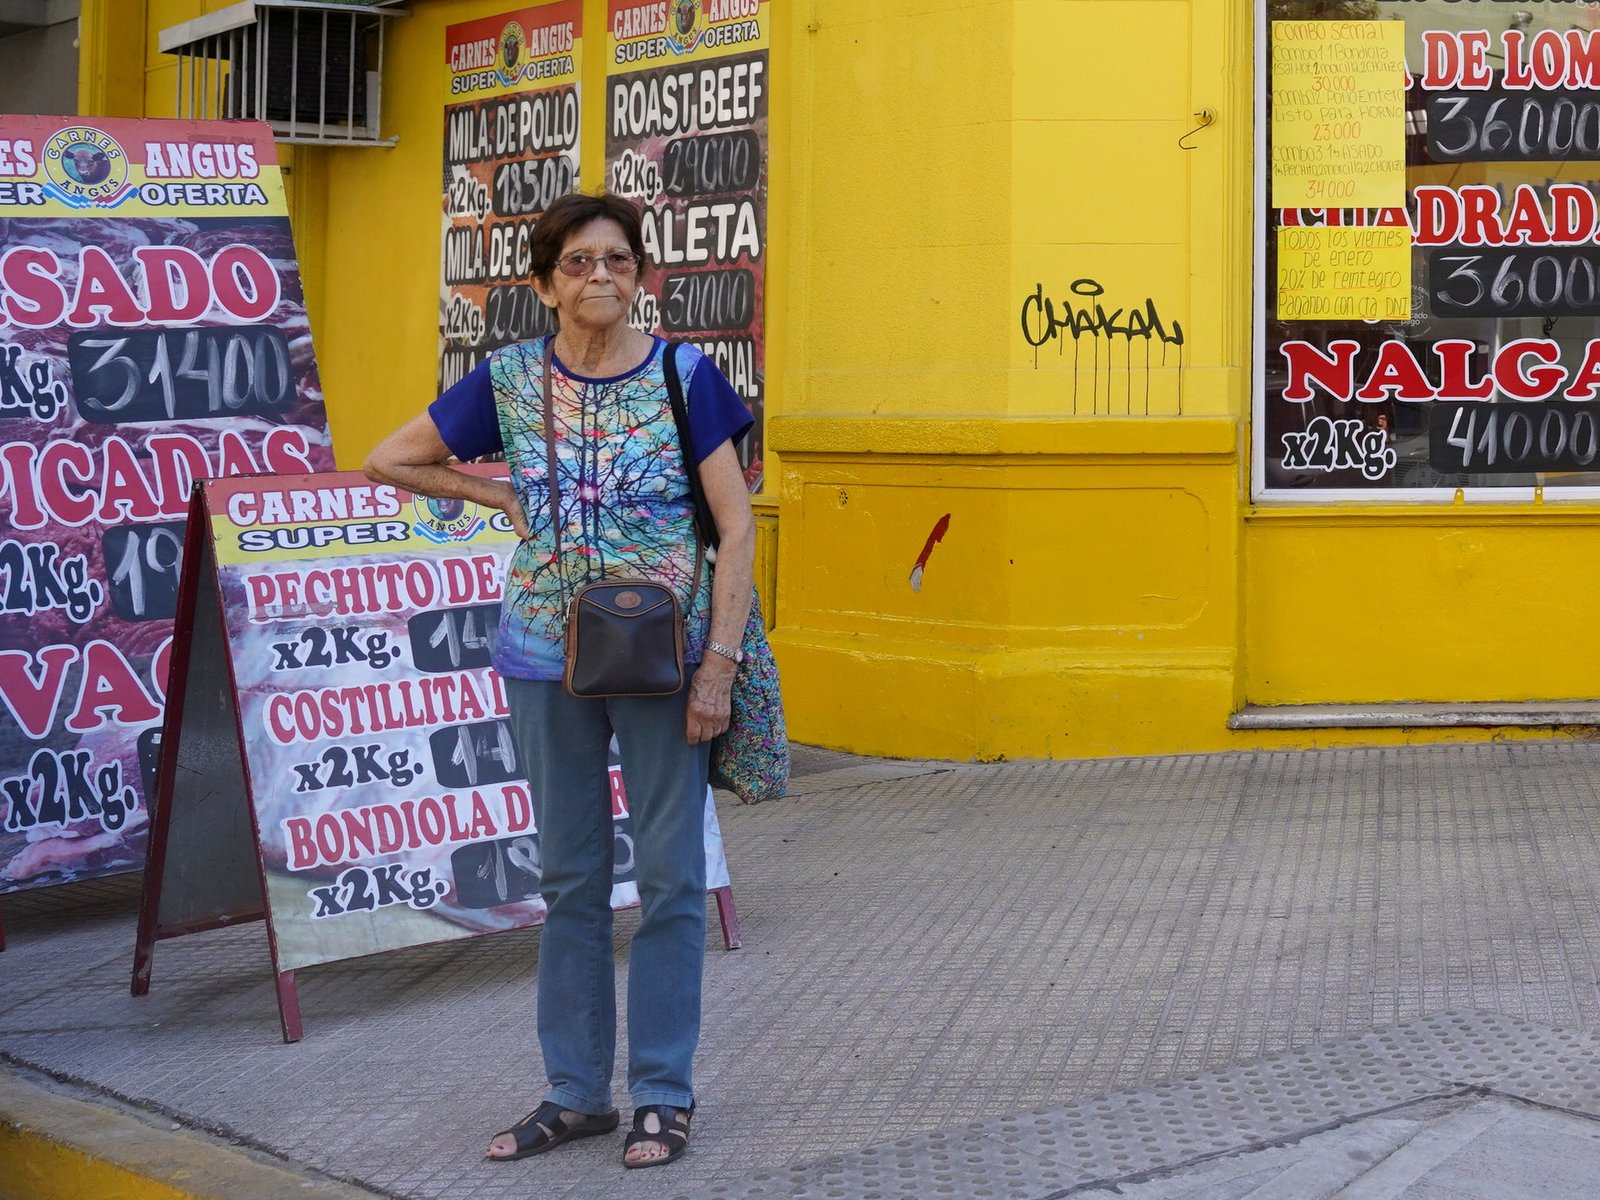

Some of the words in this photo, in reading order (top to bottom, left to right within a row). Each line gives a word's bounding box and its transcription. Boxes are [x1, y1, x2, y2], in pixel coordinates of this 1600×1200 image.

[450, 38, 496, 73] CARNES
[530, 21, 574, 58] ANGUS
[613, 1, 667, 41] CARNES
[614, 37, 667, 64] SUPER
[704, 21, 760, 48] OFERTA
[451, 70, 497, 94] SUPER
[526, 55, 574, 80] OFERTA
[1422, 29, 1493, 91] DE
[614, 74, 694, 137] ROAST
[700, 61, 763, 124] BEEF
[1435, 96, 1600, 155] 36000
[47, 130, 121, 160] CARNES
[449, 107, 492, 161] MILA.
[496, 102, 516, 155] DE
[520, 91, 576, 149] POLLO
[145, 141, 260, 179] ANGUS
[613, 155, 662, 199] x2Kg.
[668, 137, 749, 191] 29000
[60, 179, 119, 197] ANGUS
[139, 182, 268, 207] OFERTA
[449, 176, 491, 221] x2Kg.
[496, 158, 573, 213] 18500
[446, 228, 486, 281] MILA.
[490, 226, 514, 277] DE
[641, 201, 760, 264] ALETA
[1330, 250, 1373, 266] enero
[0, 244, 280, 328] SADO
[667, 271, 750, 330] 30000
[1280, 268, 1304, 290] 20%
[1333, 270, 1401, 292] reintegro
[1334, 296, 1353, 316] con
[1386, 297, 1407, 316] DNI
[1437, 254, 1600, 306] 3600
[444, 295, 485, 344] x2Kg.
[78, 331, 289, 420] 31400
[1281, 416, 1398, 481] x2Kg.
[1447, 406, 1600, 466] 41000
[227, 484, 401, 526] CARNES
[427, 514, 471, 533] ANGUS
[239, 520, 410, 551] SUPER
[0, 538, 104, 624] 2Kg.
[247, 559, 437, 622] PECHITO
[440, 553, 502, 605] DE
[272, 626, 402, 671] x2Kg.
[267, 671, 484, 744] COSTILLITA
[2, 749, 138, 833] x2Kg.
[294, 745, 424, 793] x2Kg.
[285, 789, 499, 869] BONDIOLA
[315, 865, 450, 919] x2Kg.
